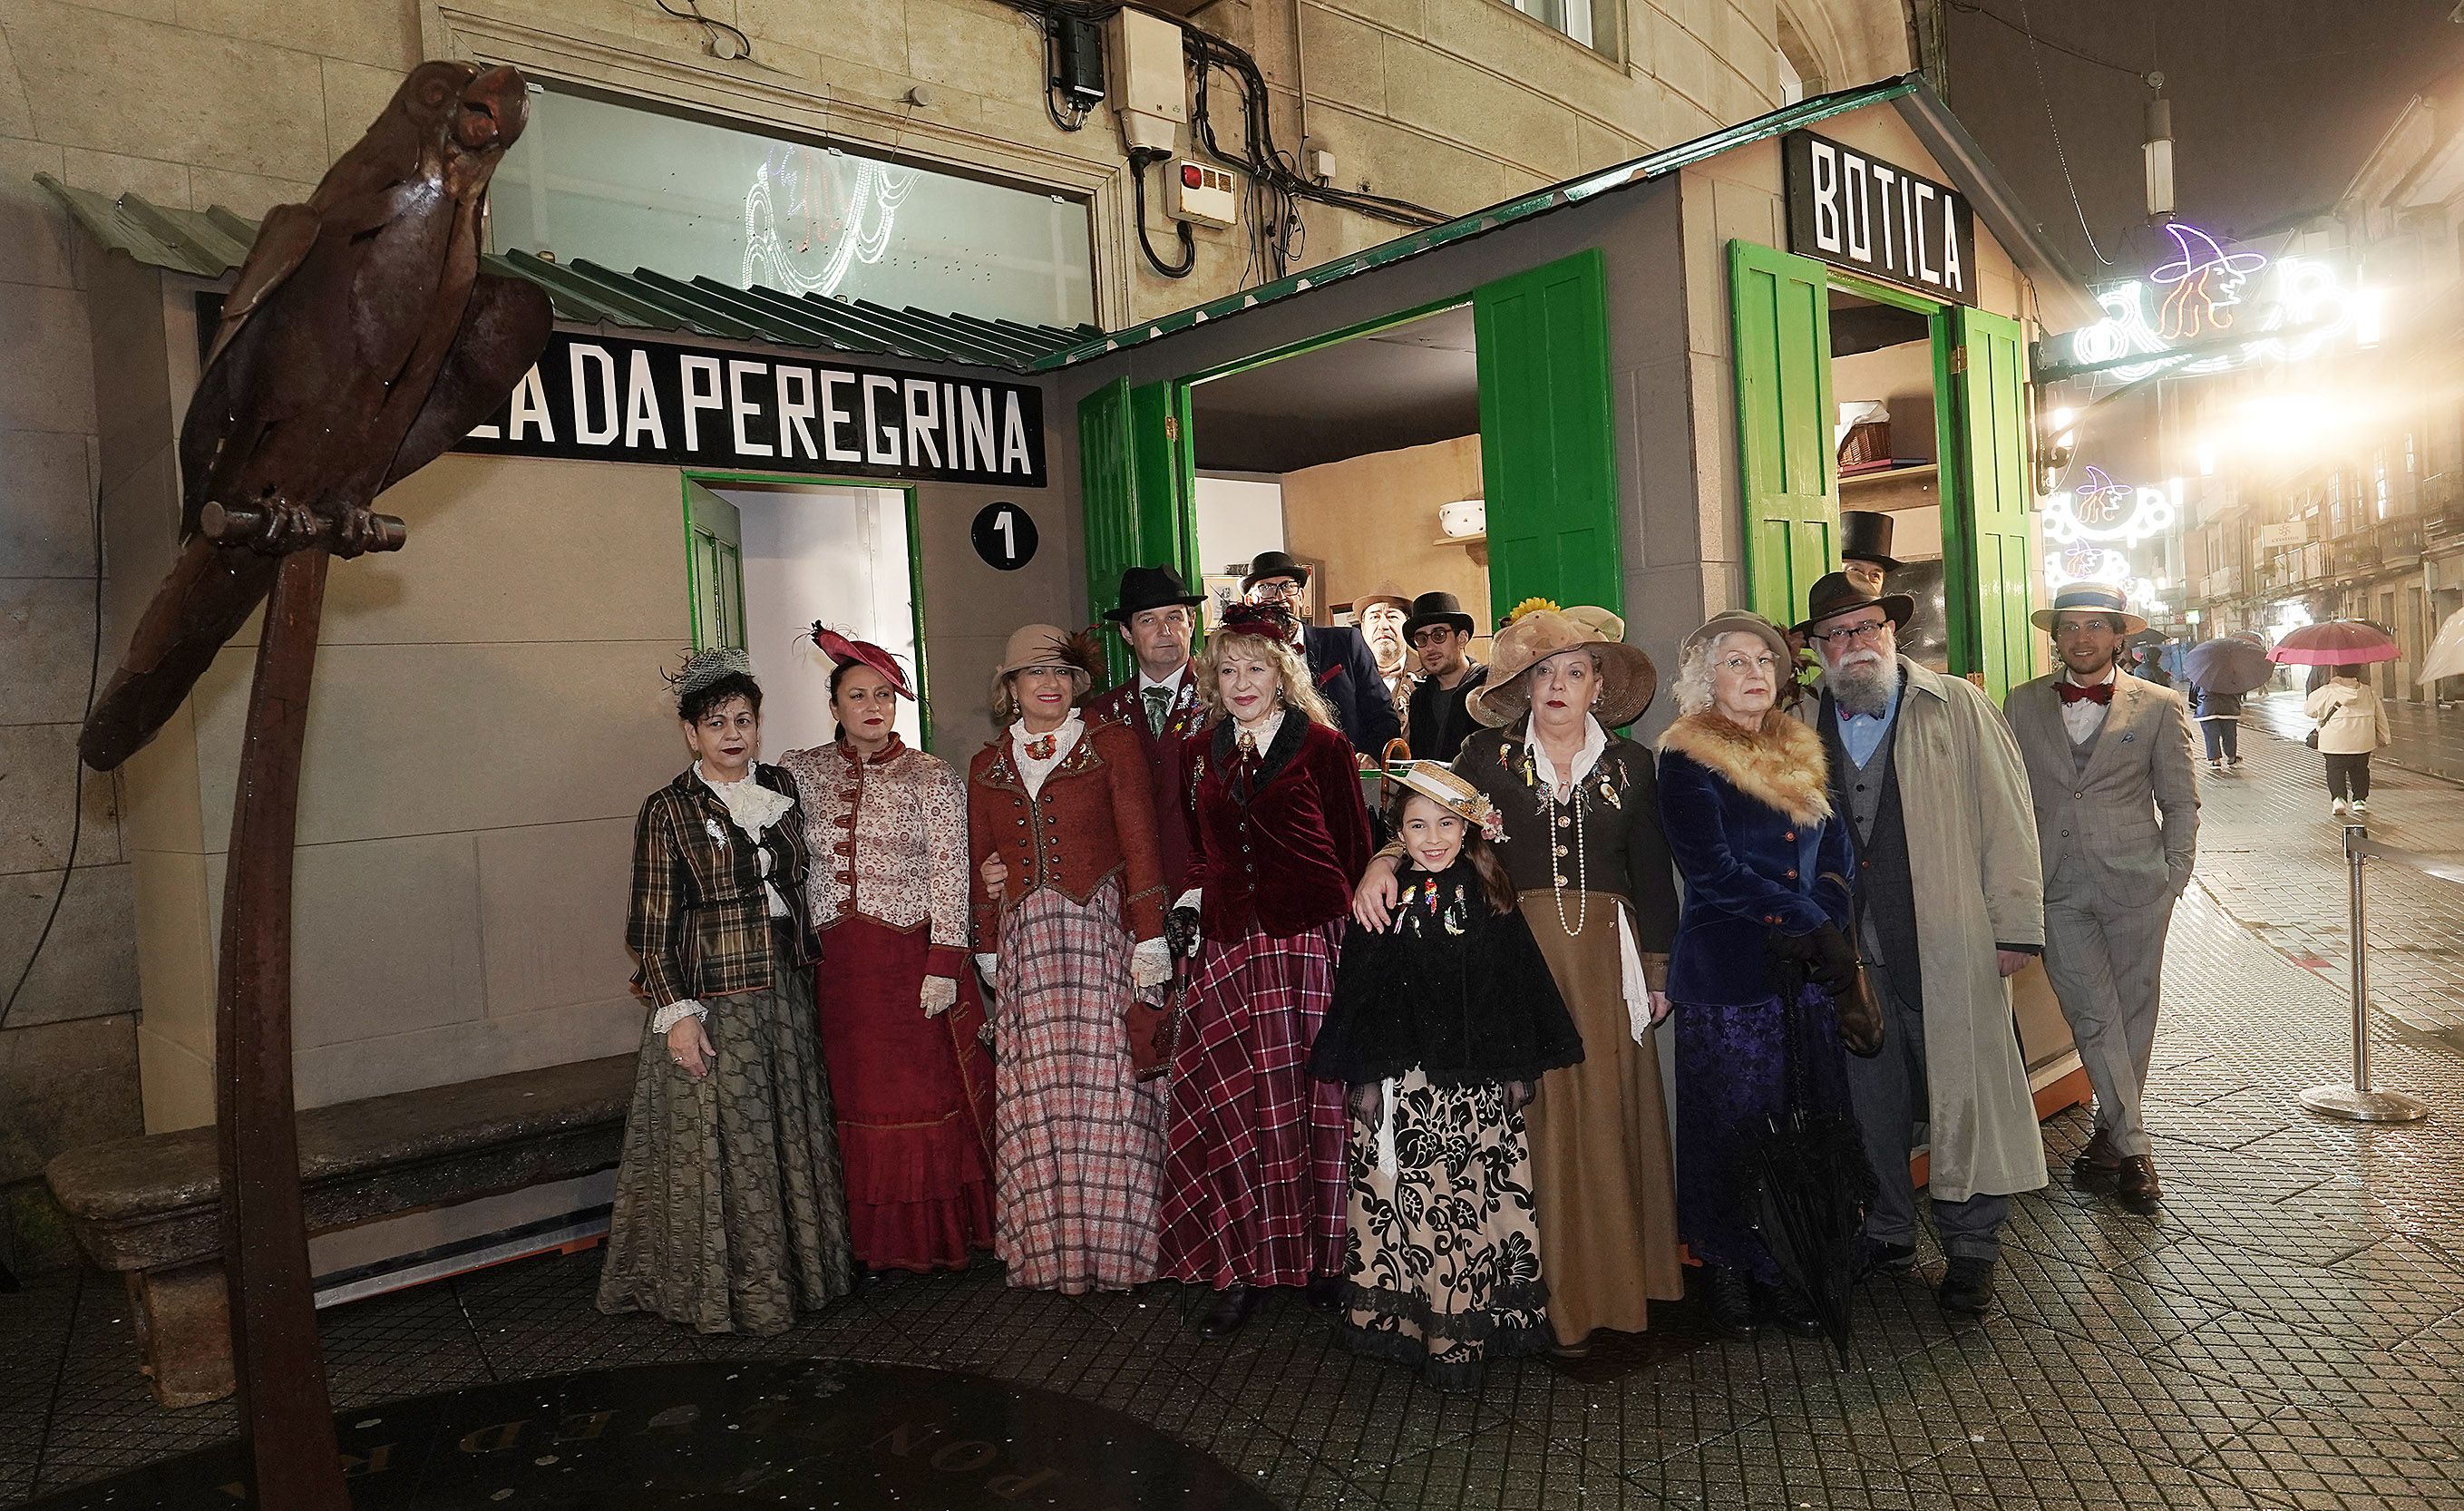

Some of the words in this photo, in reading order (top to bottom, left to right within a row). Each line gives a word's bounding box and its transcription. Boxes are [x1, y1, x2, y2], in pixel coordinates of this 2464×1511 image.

[1811, 140, 1963, 293] BOTICA
[466, 361, 555, 442] A
[569, 342, 667, 449] DA
[679, 354, 1032, 474] PEREGRINA
[993, 511, 1016, 559] 1
